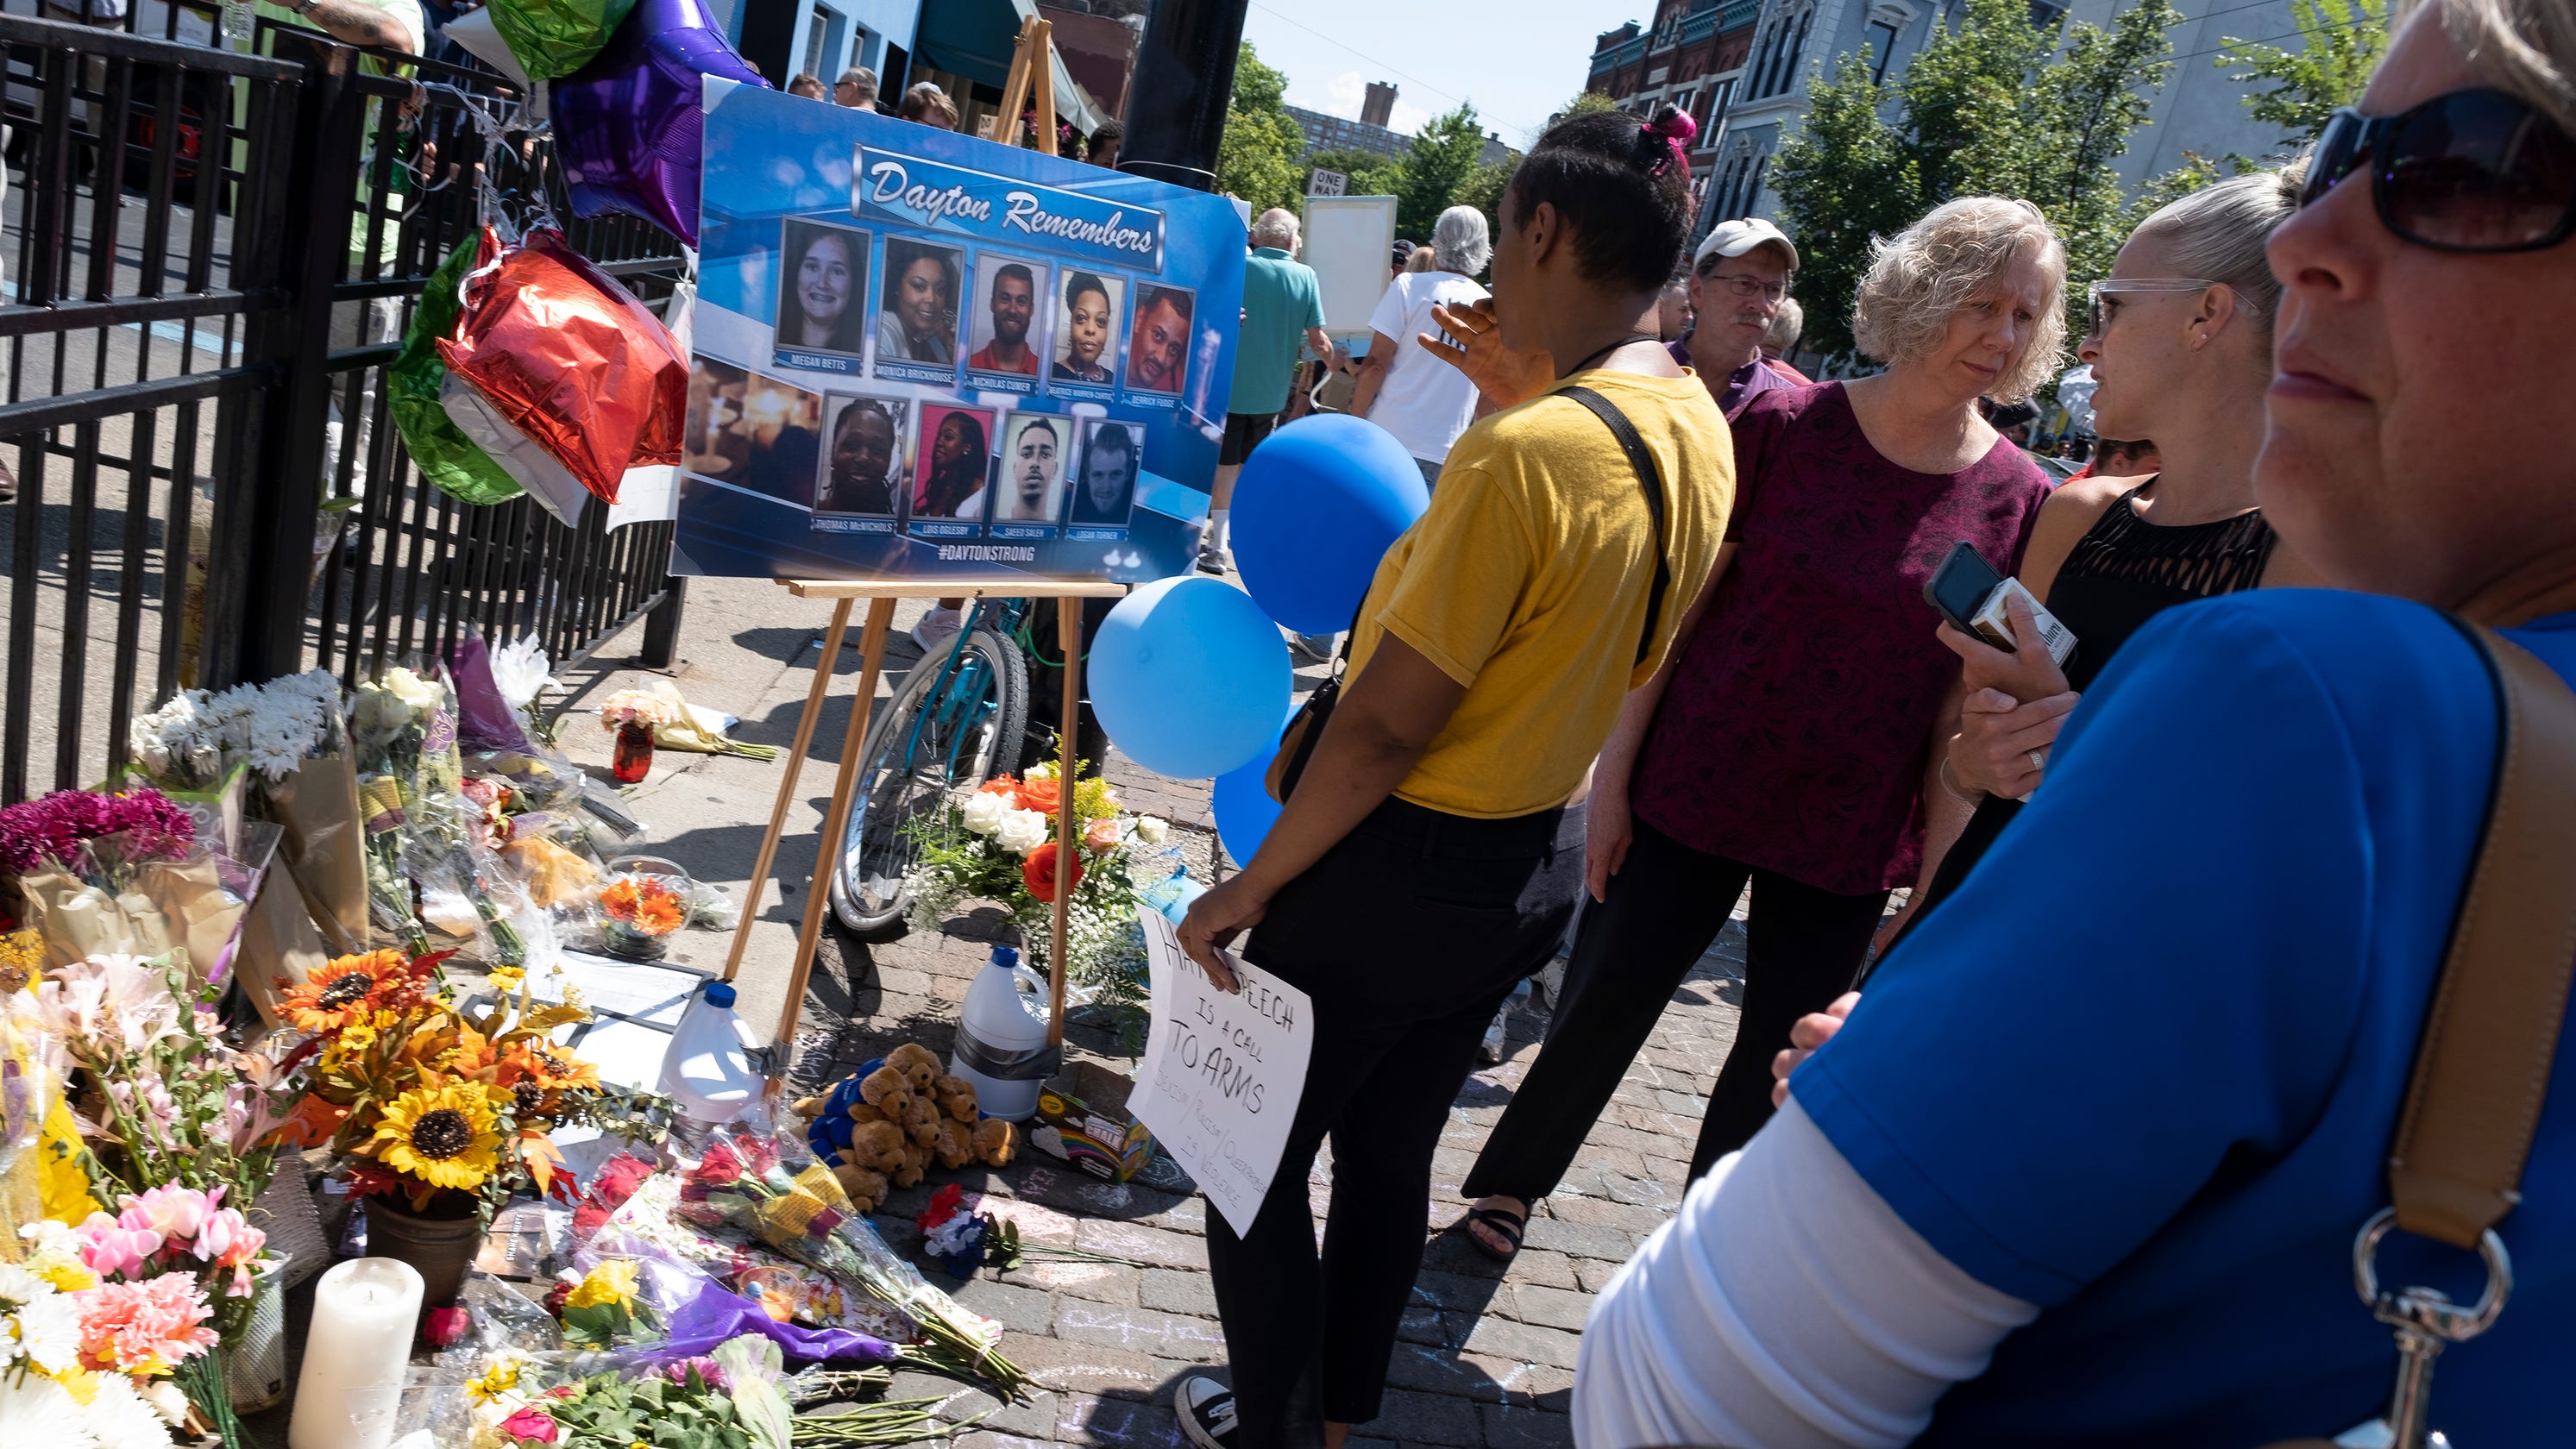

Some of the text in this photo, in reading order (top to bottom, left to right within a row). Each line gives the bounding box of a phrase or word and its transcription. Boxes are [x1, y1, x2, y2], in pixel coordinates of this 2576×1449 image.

[1317, 172, 1341, 187] ONE
[1314, 184, 1339, 196] WAY
[870, 161, 1153, 253] Dayton Remembers
[791, 354, 847, 371] MEGAN BETTS
[876, 365, 952, 383] MONICA BRICKHOUSE
[973, 376, 1031, 392] NICHOLAS CUMER
[1131, 394, 1175, 408] DERRICK FUDGE
[816, 519, 893, 532] THOMAS McNICHOLS
[922, 524, 968, 536] LOIS OGLESBY
[1004, 526, 1044, 537] SAEED SALEH
[1076, 530, 1118, 540] LOGAN TURNER
[939, 545, 1035, 561] #DAYTONSTRONG
[1228, 966, 1294, 1033] PEECH
[1195, 996, 1262, 1063] IS A CALL
[1170, 1019, 1265, 1114] TO ARMS
[1087, 1125, 1123, 1151] CHALK
